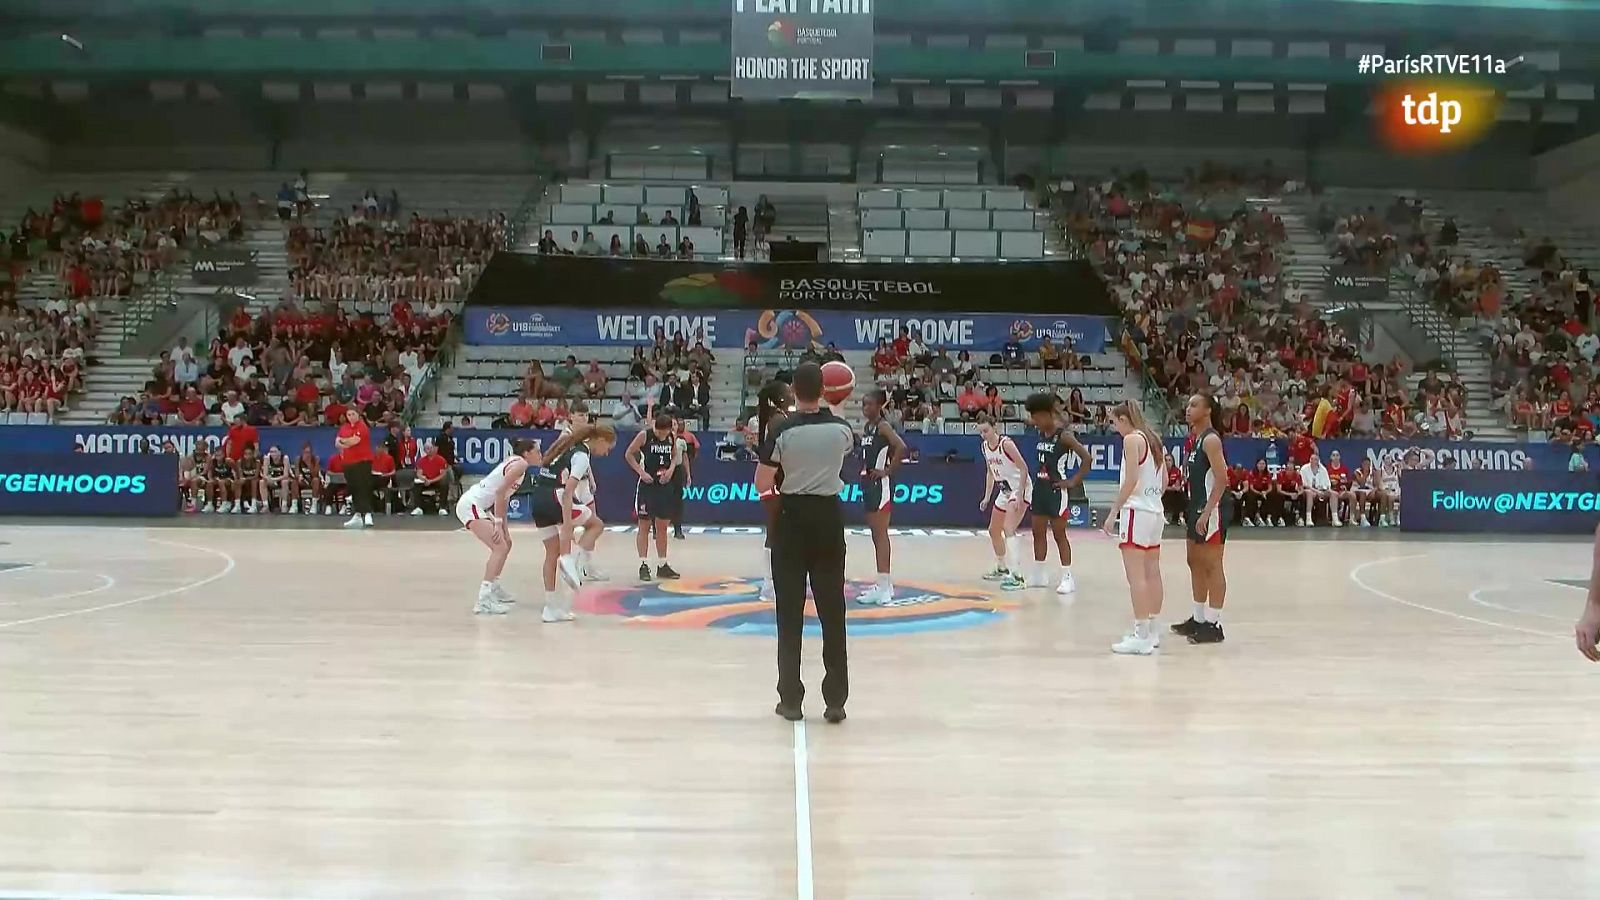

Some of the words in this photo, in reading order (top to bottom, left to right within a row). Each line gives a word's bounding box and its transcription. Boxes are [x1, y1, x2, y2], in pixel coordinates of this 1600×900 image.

[735, 56, 788, 80] HONOR
[791, 57, 817, 80] THE
[821, 58, 870, 80] SPORT
[779, 291, 877, 301] PORTUGAL
[780, 279, 941, 294] BASQUETEBOL
[597, 315, 717, 341] WELCOME
[76, 434, 228, 458] MATOSNHO
[416, 437, 542, 464] WLCO
[1366, 447, 1527, 470] MSINHOS
[1431, 490, 1493, 510] Follow
